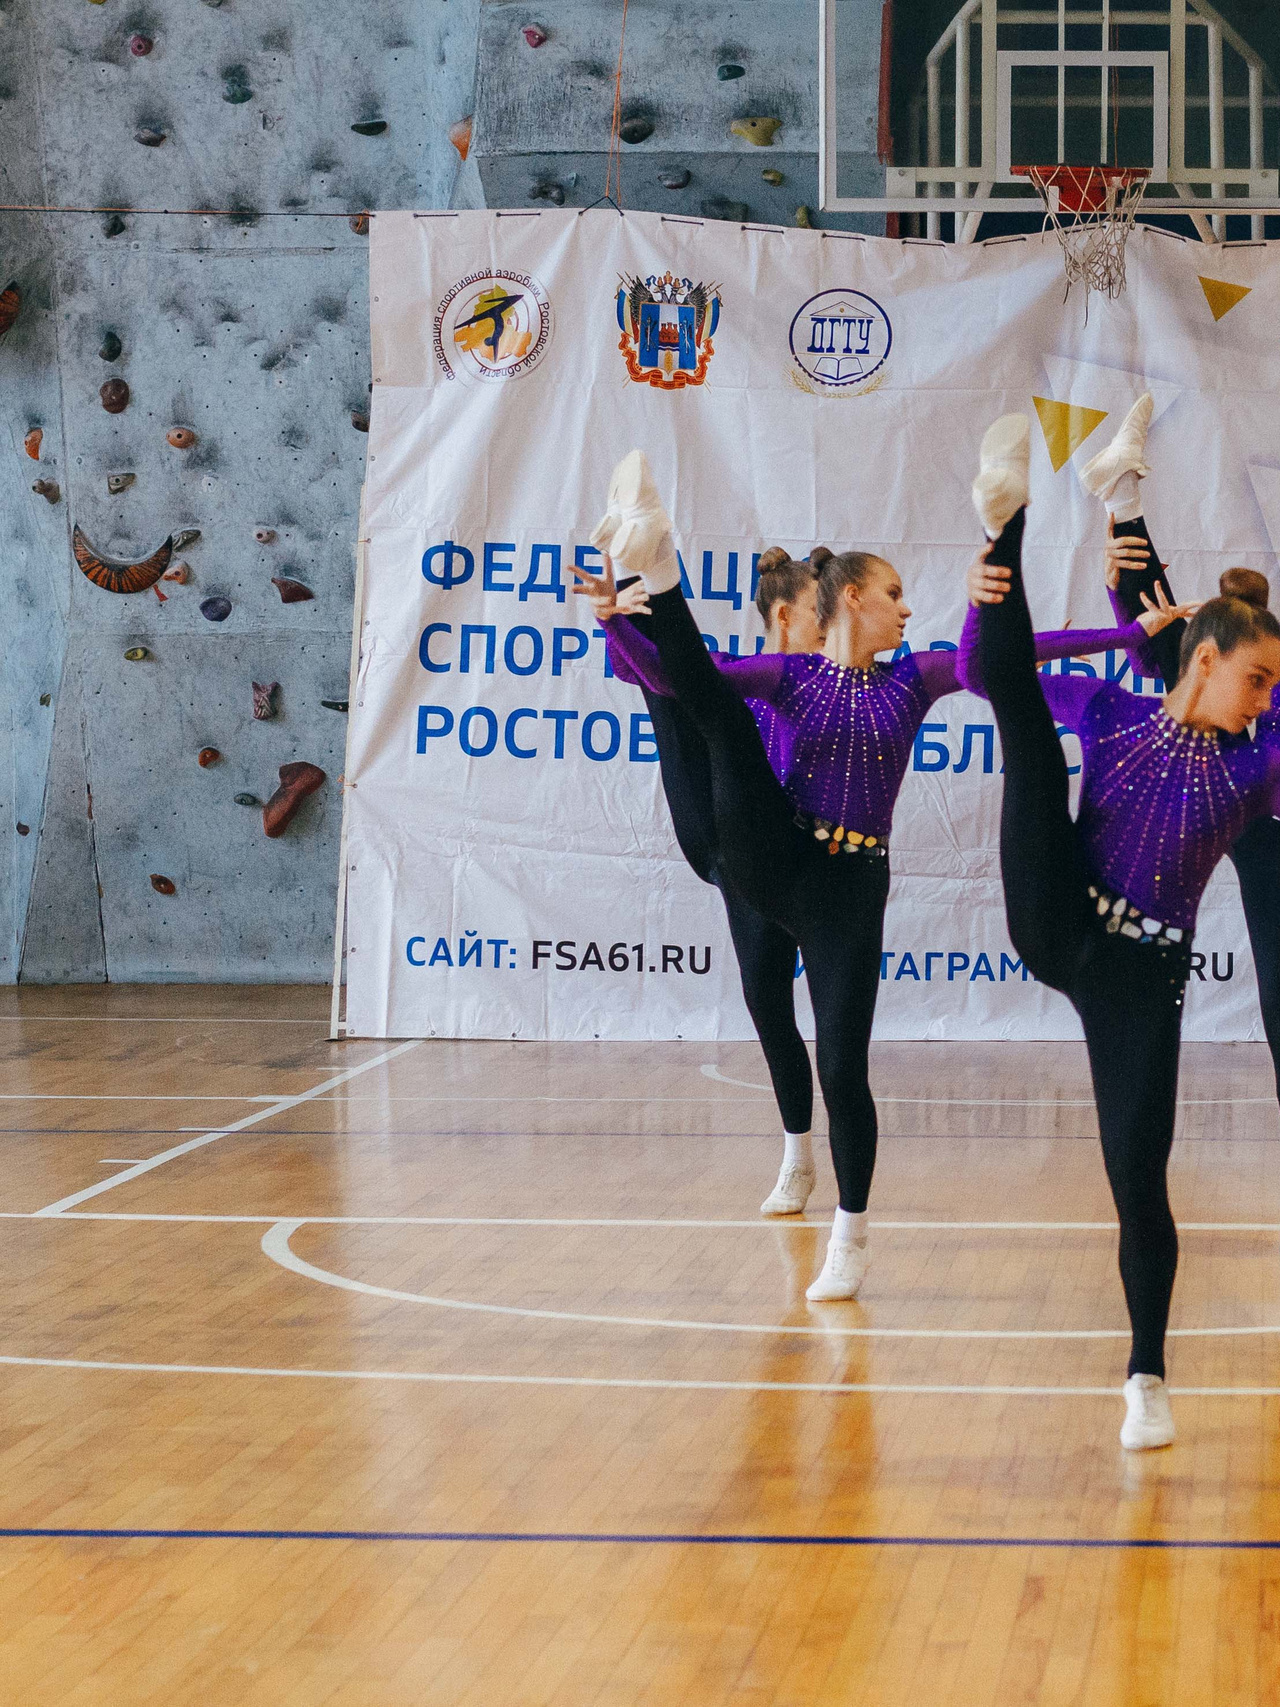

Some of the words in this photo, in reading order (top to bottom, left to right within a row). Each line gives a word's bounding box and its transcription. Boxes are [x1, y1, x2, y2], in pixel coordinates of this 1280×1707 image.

[437, 267, 493, 315] спортивной
[495, 268, 542, 298] аэробики
[433, 316, 457, 382] федерация
[522, 301, 551, 370] Ростовской
[806, 317, 874, 355] ДГТУ
[415, 705, 663, 763] РОСТОВ
[406, 930, 517, 970] САЙТ:
[532, 939, 712, 975] FSA61.RU
